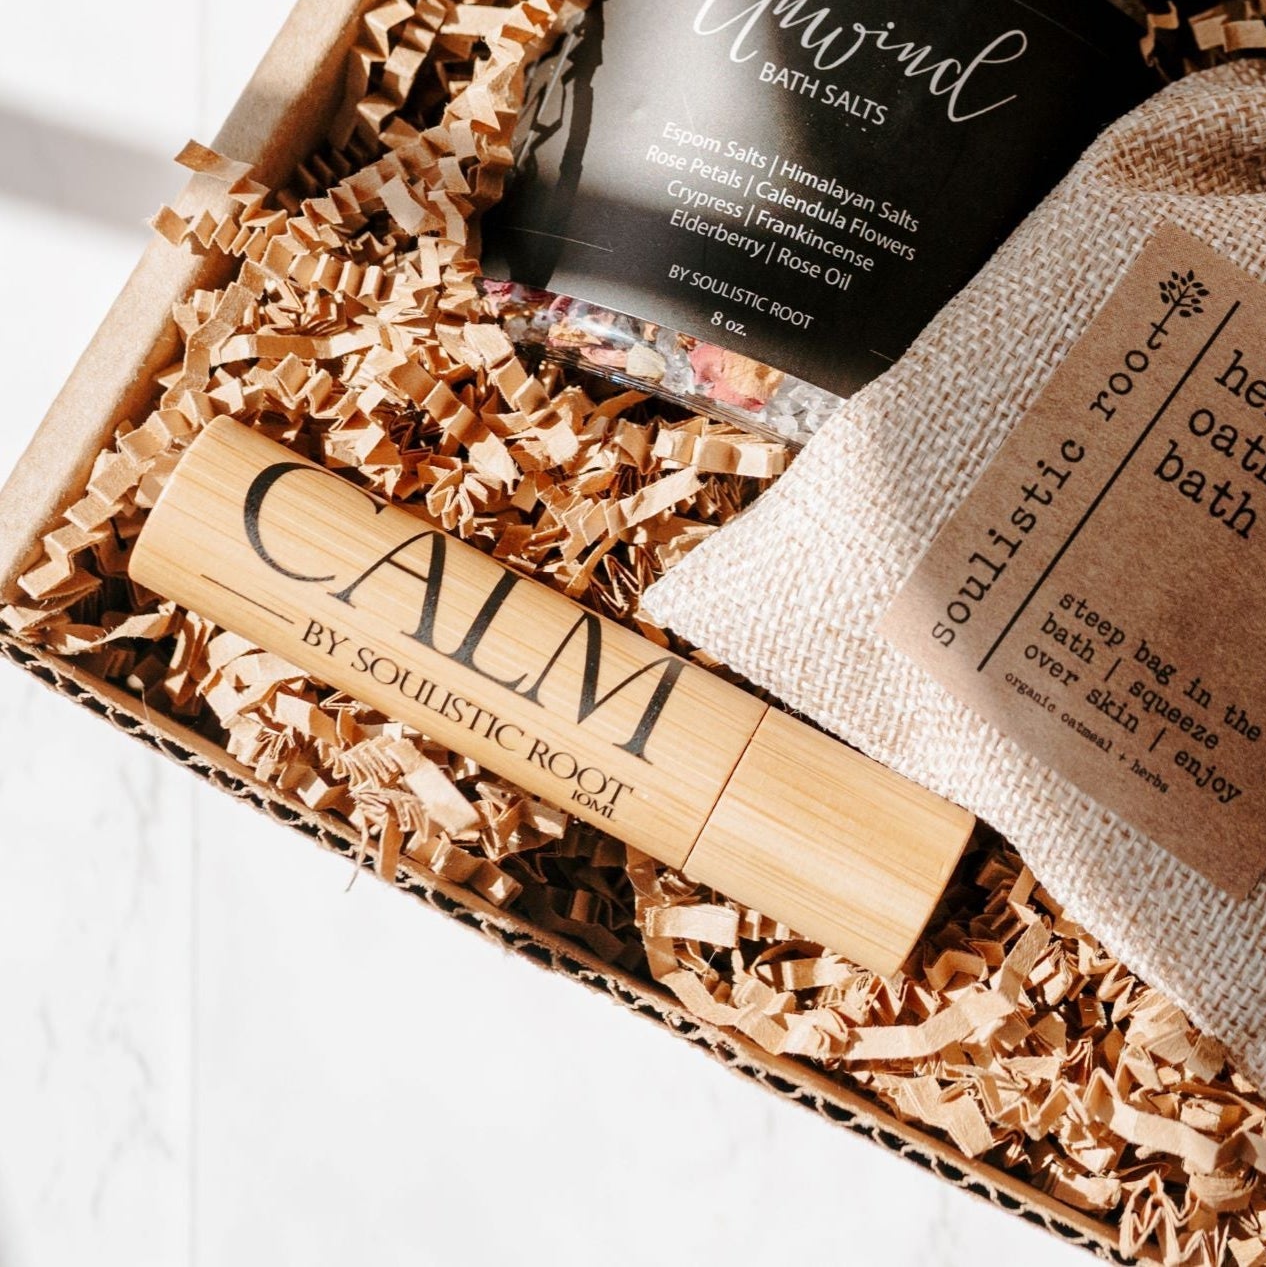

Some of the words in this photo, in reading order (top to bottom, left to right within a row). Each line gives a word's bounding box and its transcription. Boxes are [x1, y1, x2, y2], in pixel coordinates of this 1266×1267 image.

[758, 60, 821, 99] BATH
[819, 83, 889, 125] SALTS
[644, 143, 687, 171] Rose
[688, 156, 743, 189] Petals
[755, 180, 847, 230] Calendula
[847, 216, 916, 261] Flowers
[660, 120, 722, 154] Espom
[722, 139, 768, 169] Salts
[778, 159, 876, 213] Himalayan
[876, 200, 919, 233] Salts
[666, 178, 744, 218] Crypress
[754, 208, 875, 272] Frankincense
[667, 263, 691, 282] BY
[688, 271, 769, 312] SOULISTIC
[768, 300, 815, 330] ROOT
[668, 207, 766, 258] Elderberry
[775, 246, 821, 279] Rose
[823, 266, 853, 291] Oil
[709, 310, 724, 326] 8
[724, 319, 747, 337] oz.
[930, 437, 1085, 648] soulistic
[1088, 318, 1169, 423] root
[1151, 437, 1257, 540] bath
[243, 461, 692, 766] CALM
[1057, 592, 1126, 649] steep
[1132, 637, 1178, 687] bag
[1181, 675, 1212, 710] in
[1222, 702, 1262, 743] the
[300, 617, 350, 656] BY
[349, 646, 525, 749] SOULISTIC
[525, 737, 634, 806] ROOT
[1003, 671, 1057, 713] organic
[1059, 711, 1113, 754] oatmeal
[1128, 757, 1170, 794] herbs
[1022, 643, 1080, 687] over
[1084, 687, 1140, 734] skin
[1172, 749, 1243, 804] enjoy
[1039, 610, 1095, 665] bath
[1126, 679, 1220, 751] squeeze
